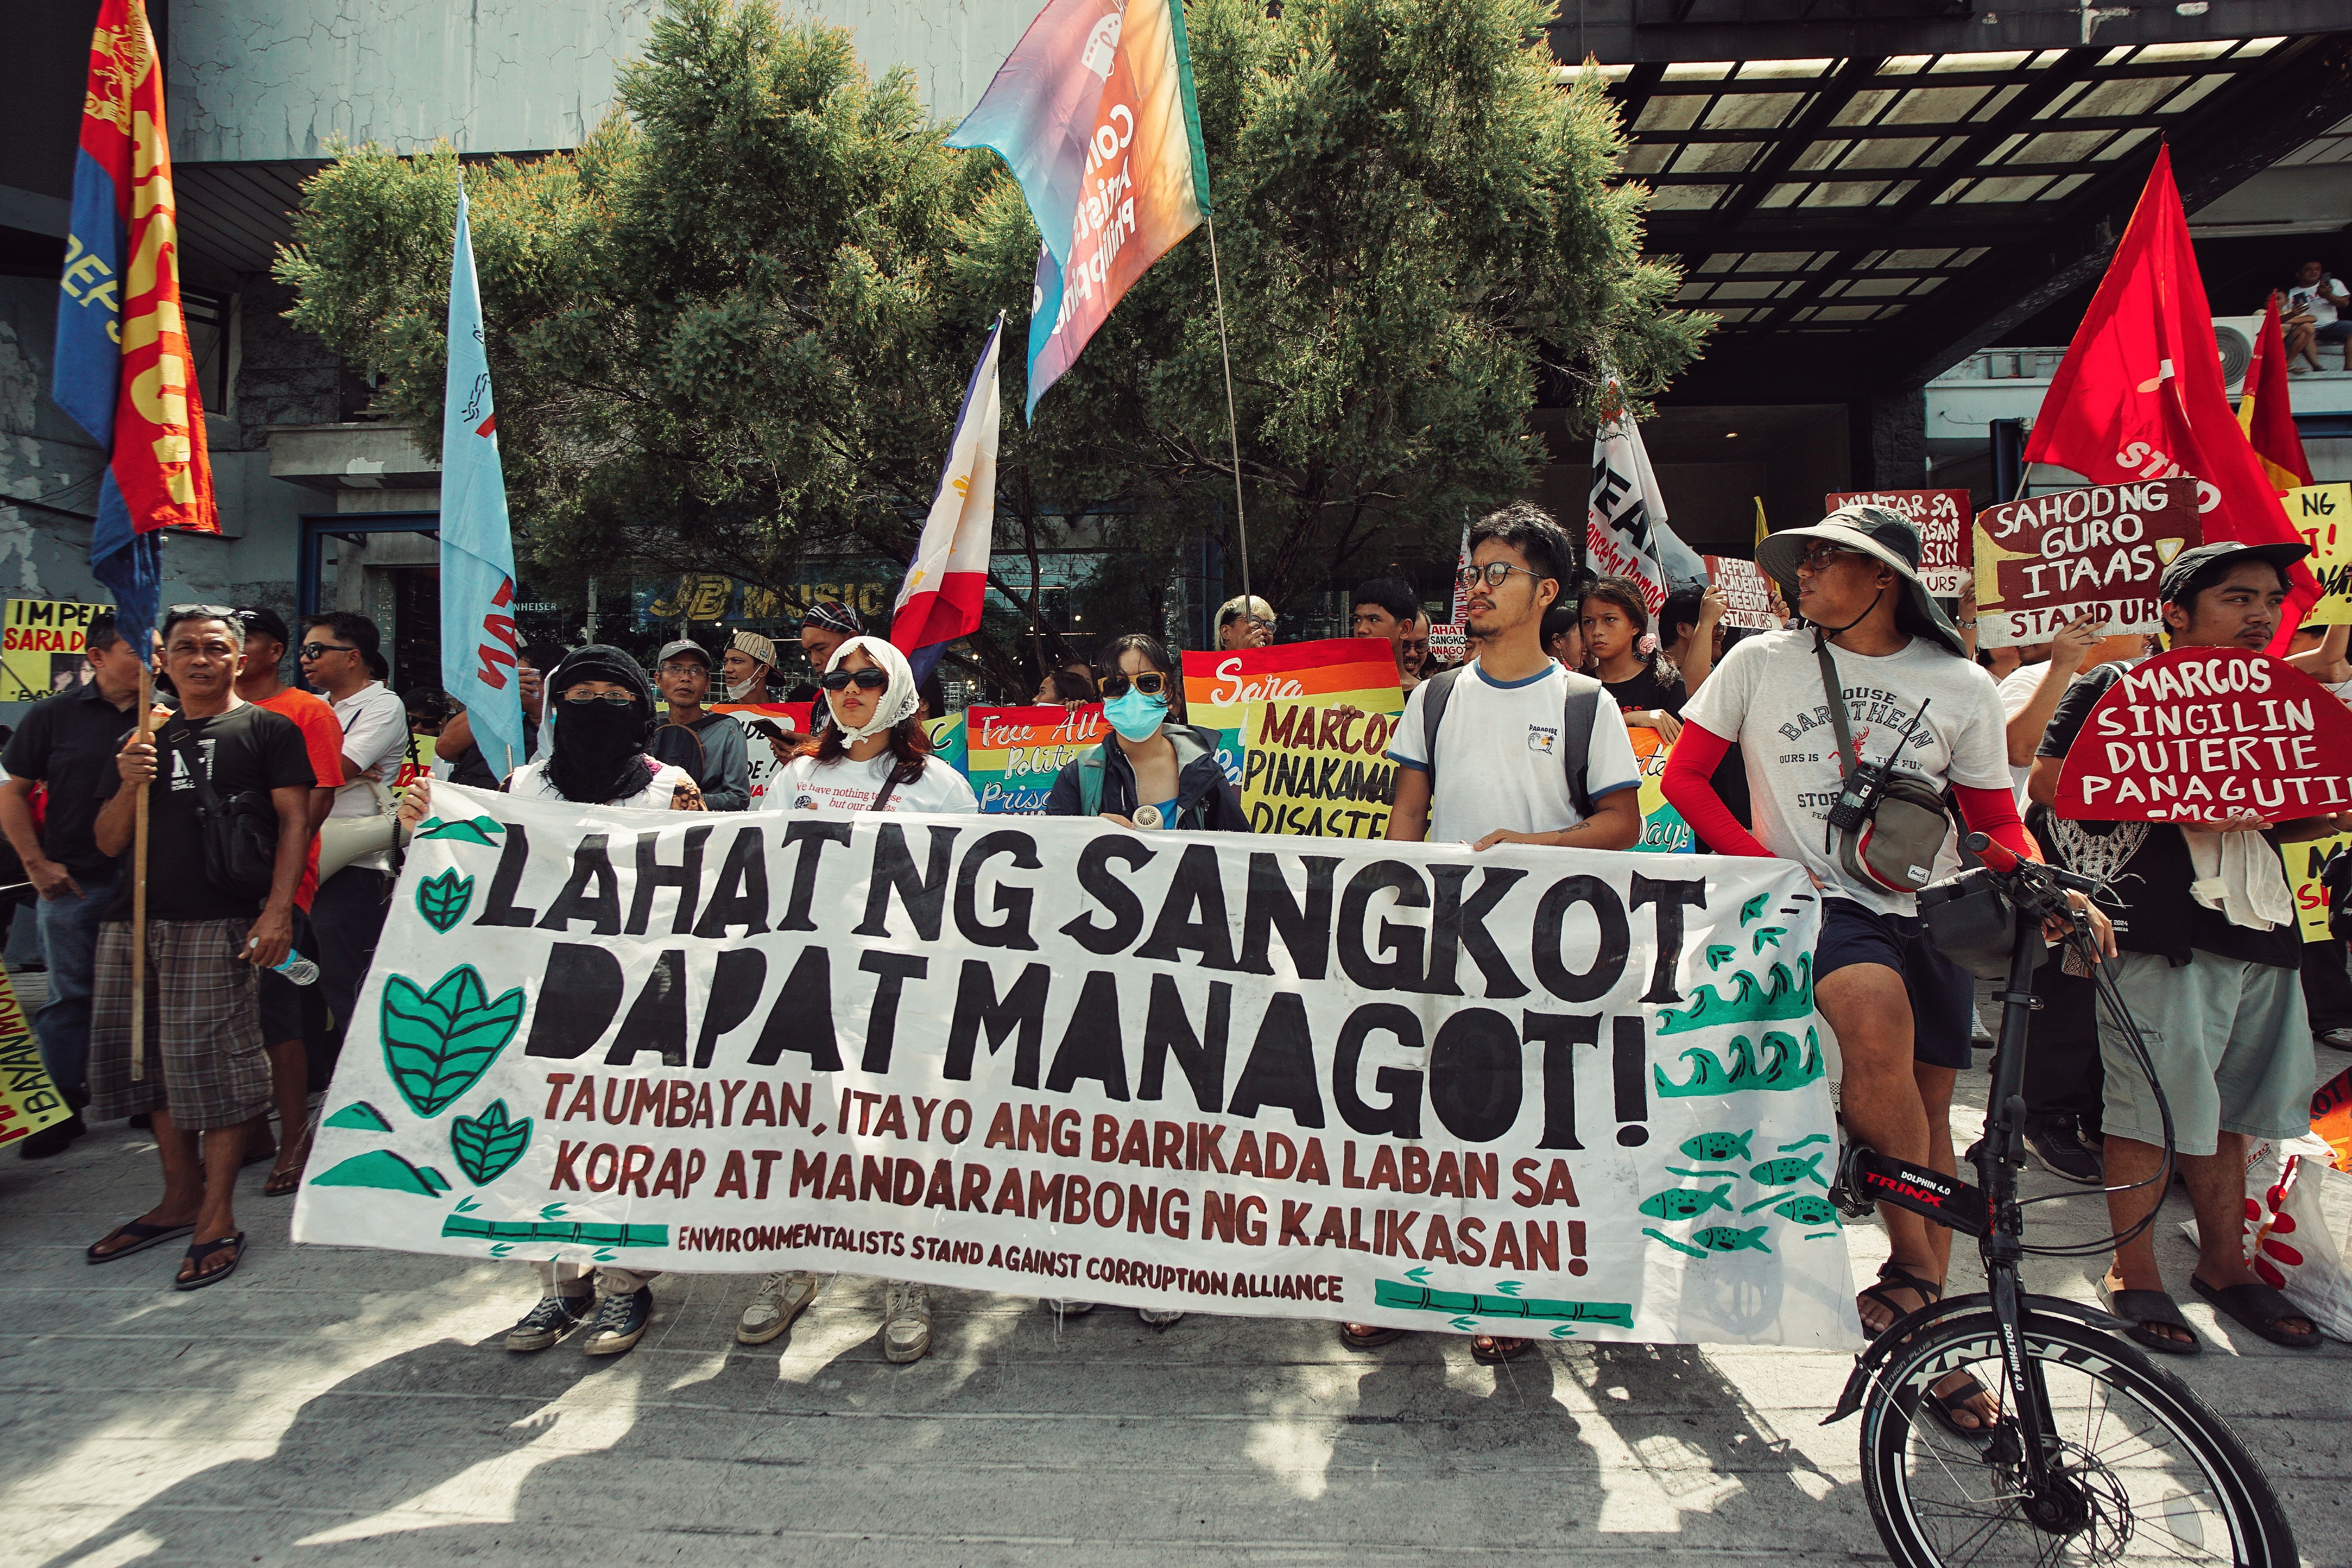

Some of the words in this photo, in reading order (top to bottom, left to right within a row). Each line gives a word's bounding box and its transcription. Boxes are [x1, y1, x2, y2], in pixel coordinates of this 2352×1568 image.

[1930, 493, 1959, 518] SA
[1994, 488, 2114, 538] SAHOD
[2120, 482, 2169, 513] NG
[2301, 492, 2337, 517] NG
[2041, 514, 2143, 559] GURO
[1717, 557, 1756, 577] DEFEND
[1715, 572, 1768, 595] ACADEMIC
[1926, 576, 1957, 592] URS
[1725, 610, 1755, 627] STAND
[1756, 613, 1773, 629] URS
[2120, 598, 2160, 625] UR
[3, 627, 65, 651] SARA
[1429, 626, 1465, 635] AHAT
[1430, 636, 1468, 644] SANGKO
[1211, 657, 1304, 708] Sara
[1842, 687, 1897, 705] OUSE
[2122, 658, 2271, 704] MARCOS
[981, 715, 1036, 747] Free
[1049, 711, 1100, 742] All
[1529, 724, 1558, 736] PARADISE
[2097, 699, 2315, 737] SINGILIN
[1004, 745, 1076, 780] Politi
[1780, 754, 1805, 764] OURS
[1808, 753, 1819, 762] IS
[2105, 735, 2321, 774] DUTERTE
[808, 783, 831, 795] have
[832, 788, 870, 801] nothing
[829, 797, 844, 807] but
[847, 802, 865, 810] our
[472, 820, 855, 939] LAHAT
[851, 822, 1044, 951] NG
[1058, 833, 1707, 1004] SANGKOT
[524, 941, 929, 1074] DAPAT
[943, 958, 1650, 1150] MANAGOT!
[544, 1073, 828, 1137] TAUMBAYAN,
[837, 1087, 973, 1145] ITAYO
[984, 1102, 1082, 1158] ANG
[1091, 1113, 1330, 1185] BARIKADA
[1342, 1140, 1499, 1200] LABAN
[1511, 1157, 1580, 1208] SA
[1865, 1171, 1945, 1208] TRINX
[1901, 1171, 1937, 1191] DOLPHIN
[1937, 1185, 1951, 1195] 4.0
[549, 1139, 706, 1199] KORAP
[714, 1149, 782, 1200] AT
[789, 1149, 1190, 1240] MANDARAMBONG
[1201, 1191, 1267, 1247] NG
[1278, 1199, 1589, 1277] KALIKASAN!
[678, 1223, 906, 1256] ENVIRONMENTALISTS
[911, 1235, 983, 1265] STAND
[987, 1243, 1083, 1279] AGAINST
[1086, 1256, 1228, 1296] CORRUPTION
[1231, 1273, 1344, 1303] ALLIANCE
[2003, 1323, 2022, 1372] DOLPHIN
[2013, 1372, 2025, 1392] 4.0
[1866, 1449, 1884, 1518] SCHWALBE
[1909, 1342, 1932, 1361] PLUS
